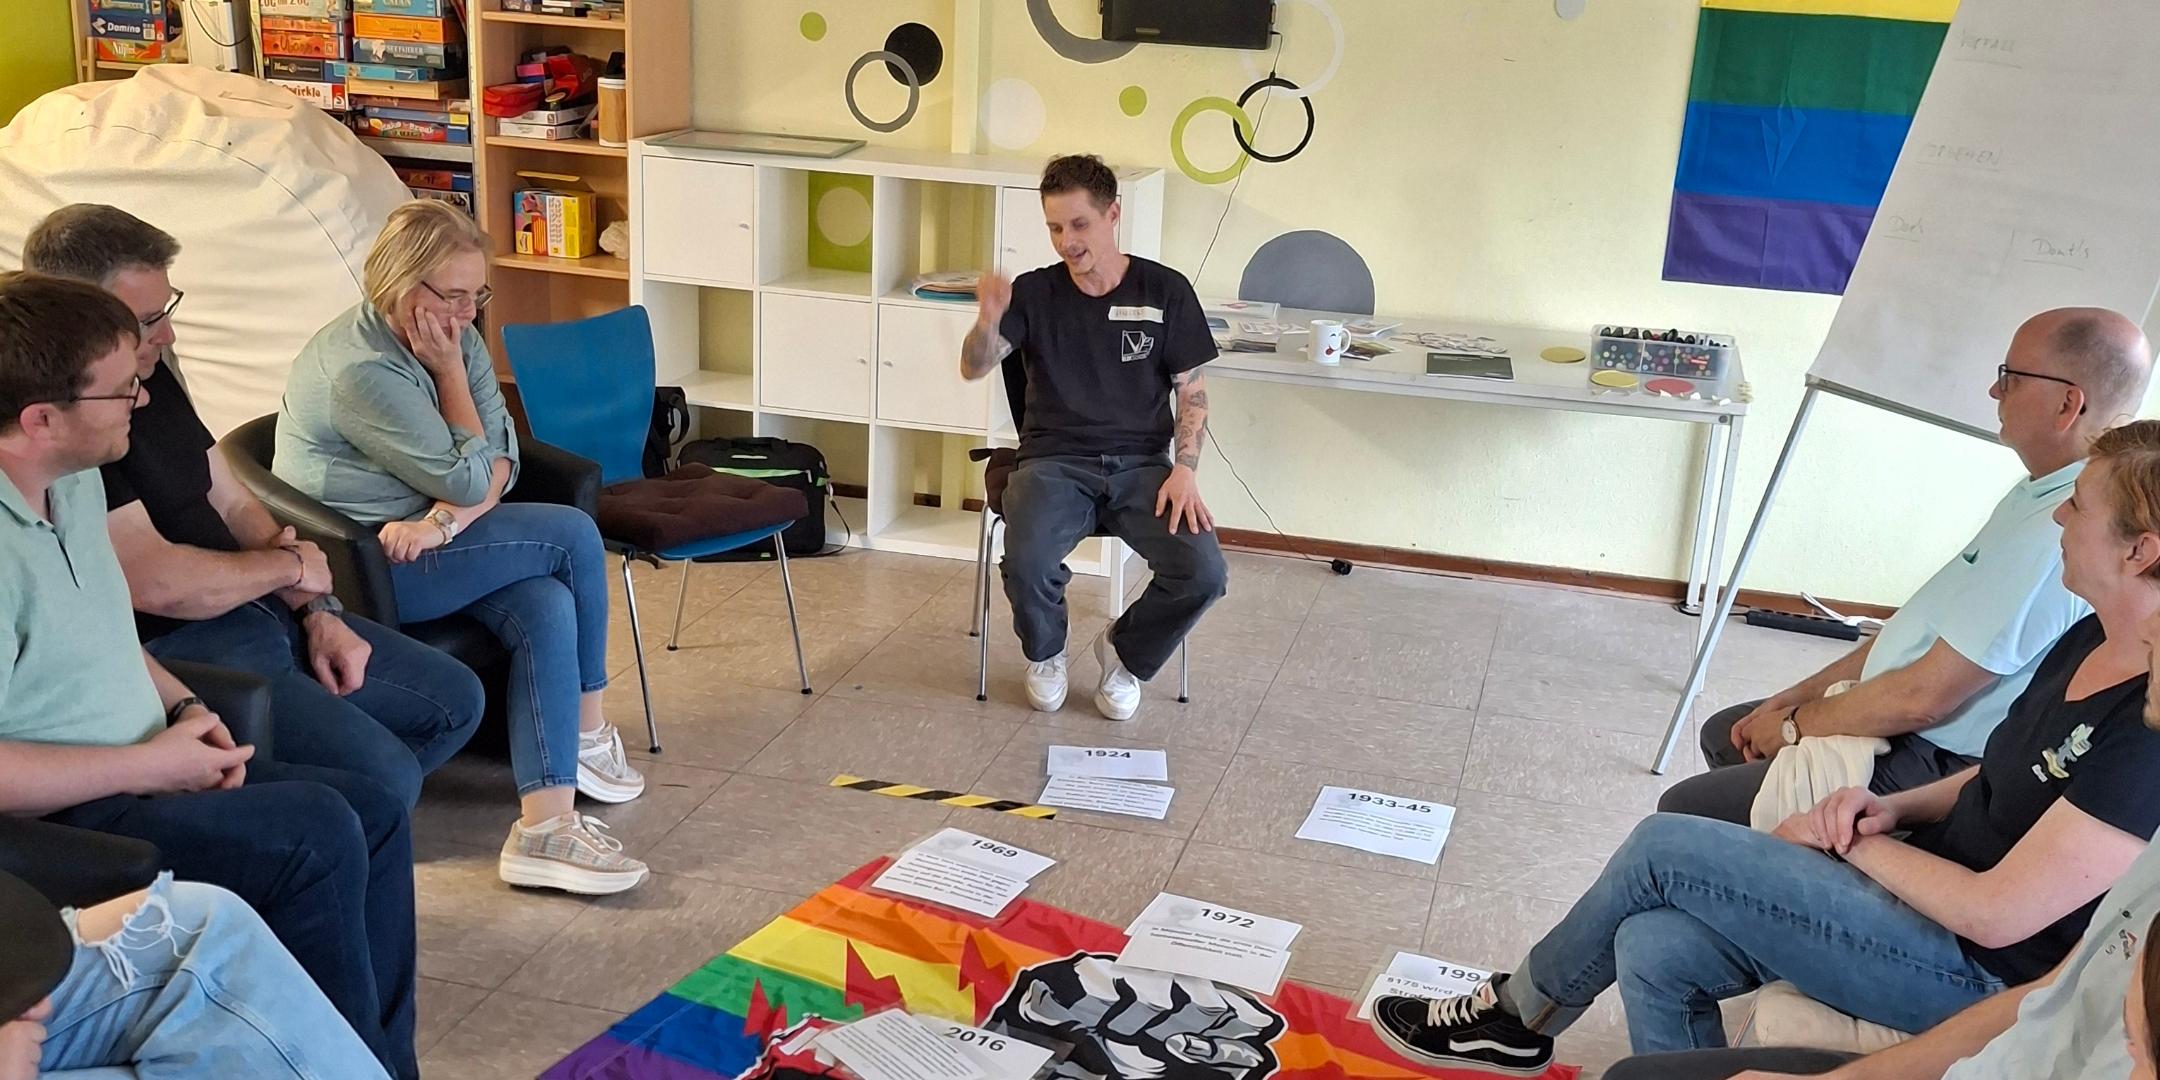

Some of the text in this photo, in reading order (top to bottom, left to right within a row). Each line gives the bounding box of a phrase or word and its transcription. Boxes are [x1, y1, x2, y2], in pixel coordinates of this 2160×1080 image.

[107, 22, 141, 34] Domino
[282, 84, 321, 98] wirkle
[1085, 750, 1131, 758] 1924
[1348, 793, 1431, 813] 1933-45
[971, 839, 1018, 858] 1969
[1200, 908, 1257, 928] 1972
[1438, 966, 1481, 982] 199
[1422, 985, 1453, 996] wird
[943, 1026, 1006, 1051] 2016
